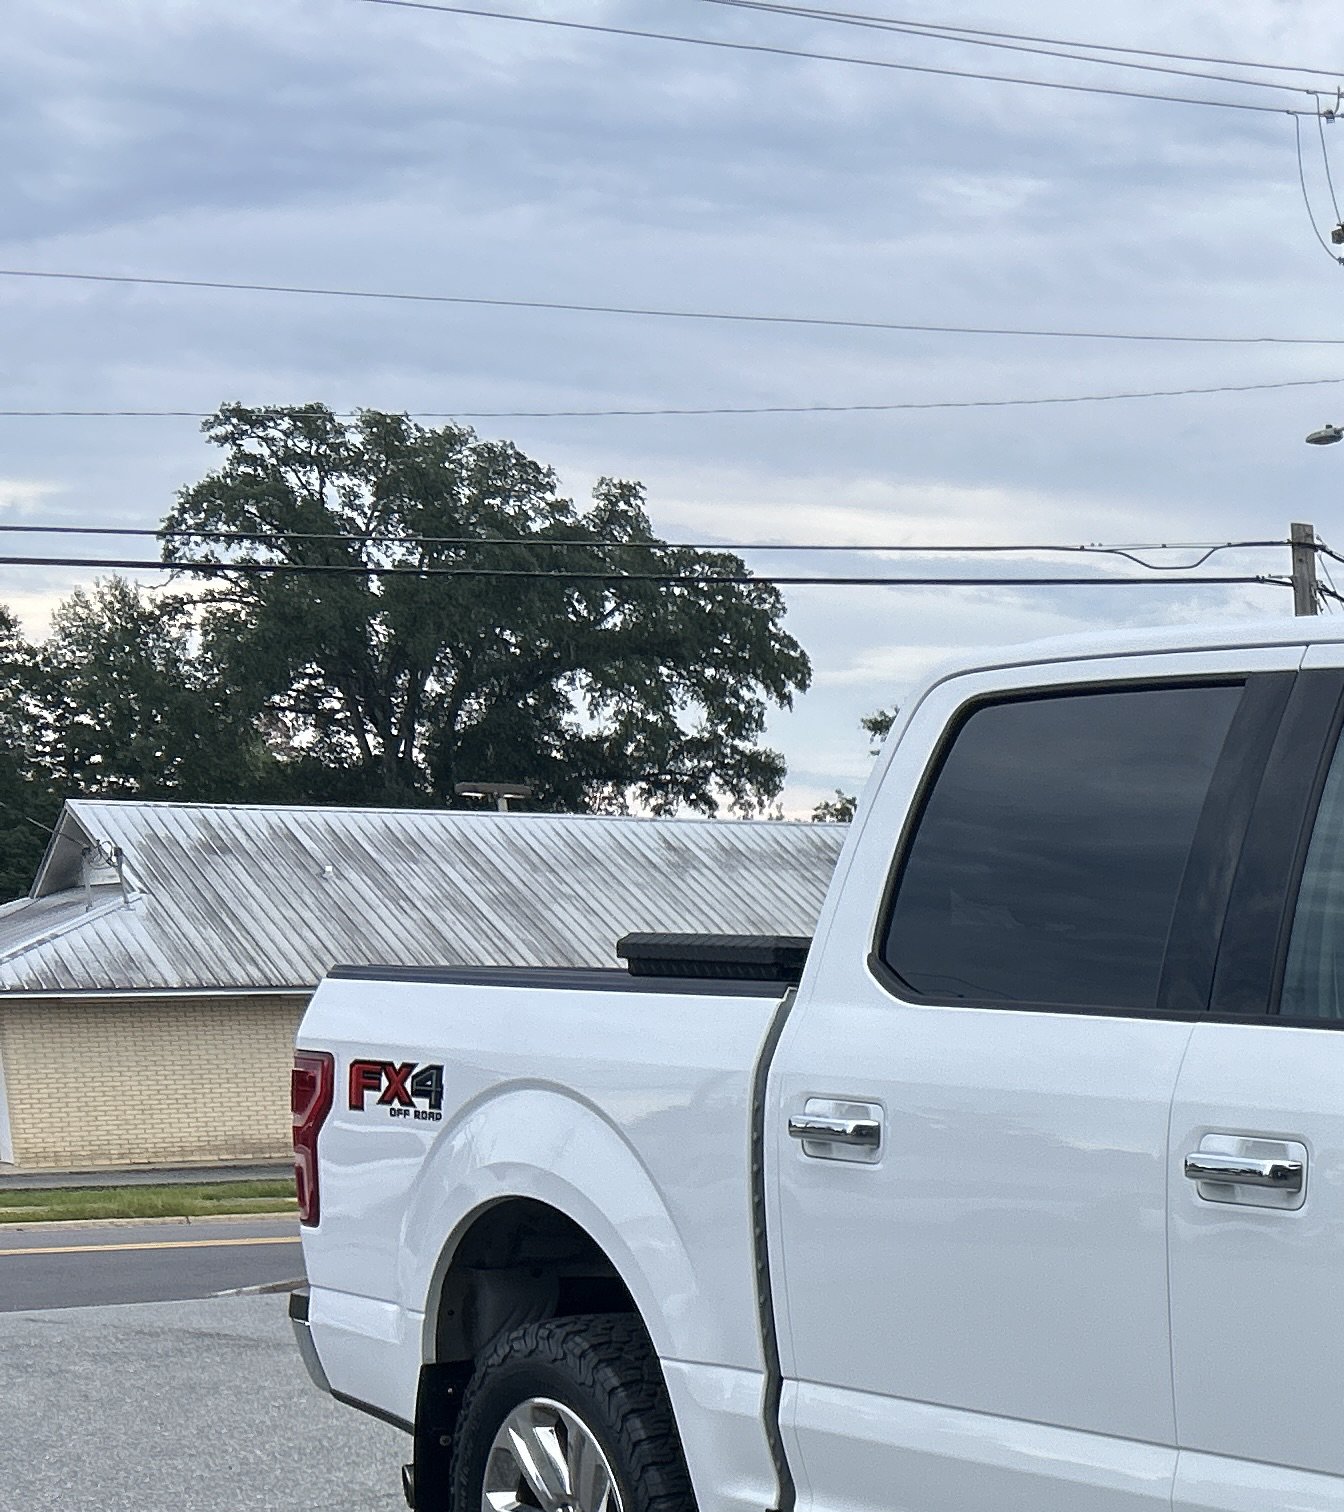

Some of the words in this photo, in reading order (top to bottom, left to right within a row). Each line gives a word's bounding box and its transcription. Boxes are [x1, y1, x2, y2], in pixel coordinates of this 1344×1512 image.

[348, 1058, 445, 1111] FX4
[389, 1107, 411, 1119] OFF
[413, 1109, 443, 1122] ROAD
